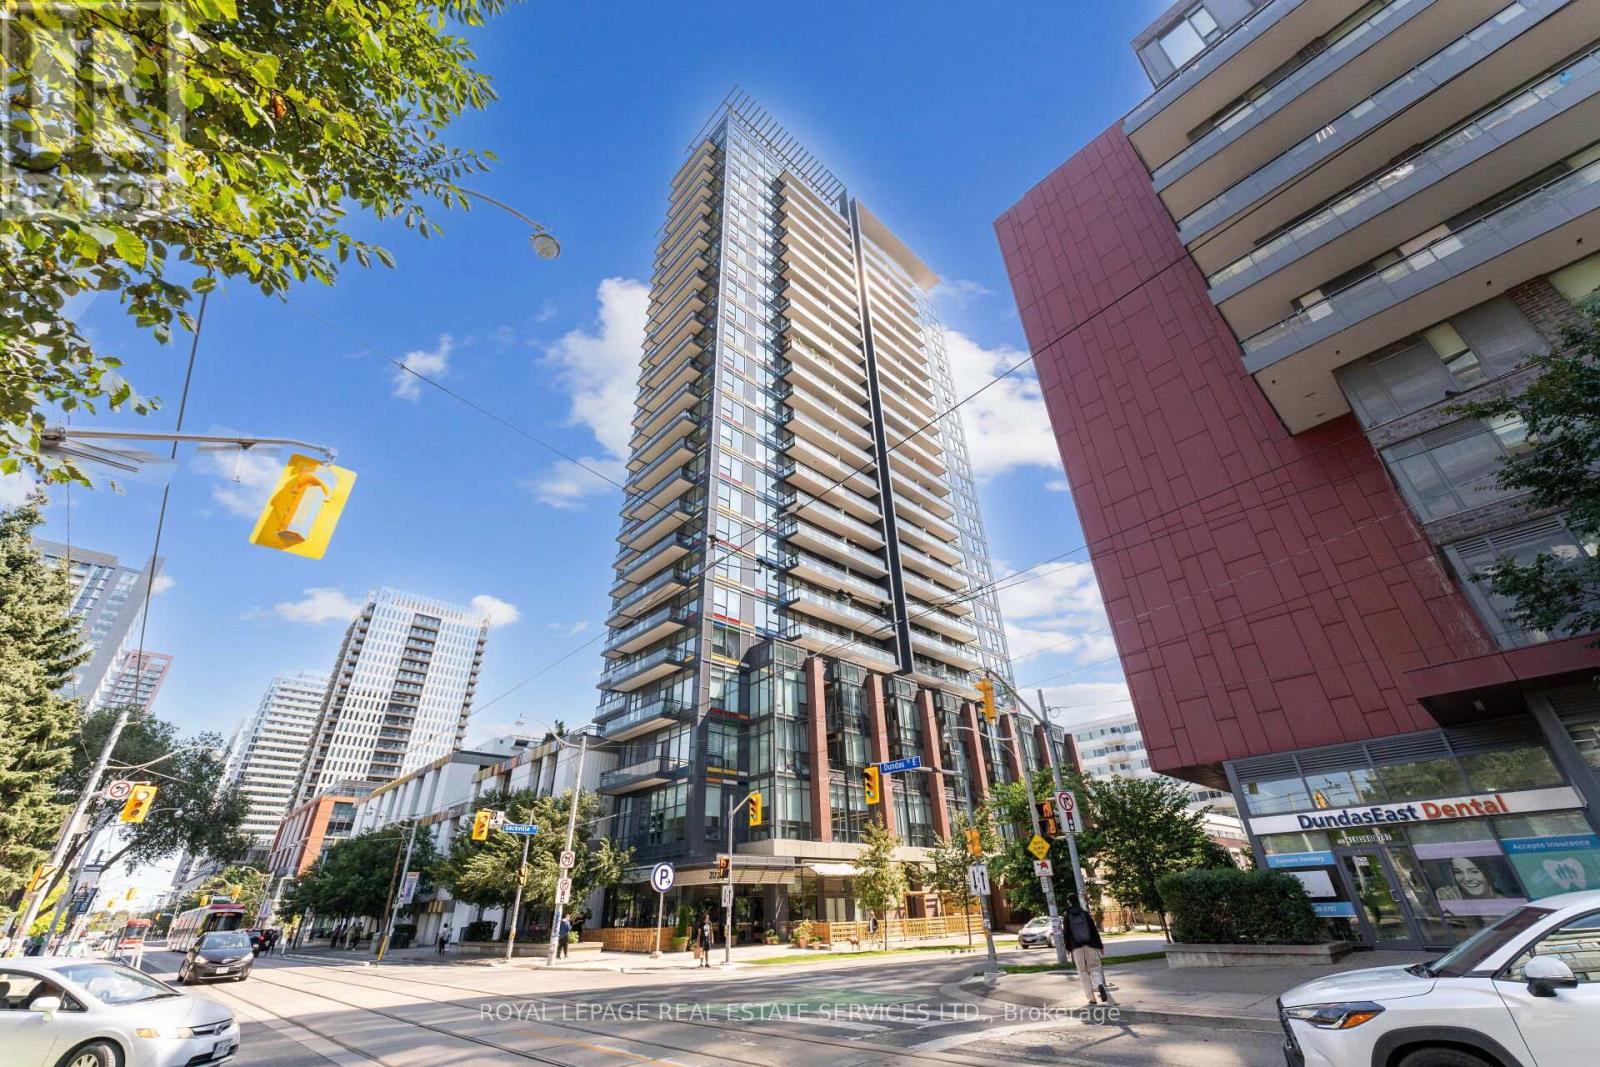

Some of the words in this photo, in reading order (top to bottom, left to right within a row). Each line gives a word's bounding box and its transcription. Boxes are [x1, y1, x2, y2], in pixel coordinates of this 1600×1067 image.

[883, 761, 905, 771] Dundas
[1297, 804, 1419, 829] DundasEast
[1421, 793, 1509, 820] Dental
[659, 869, 669, 886] P
